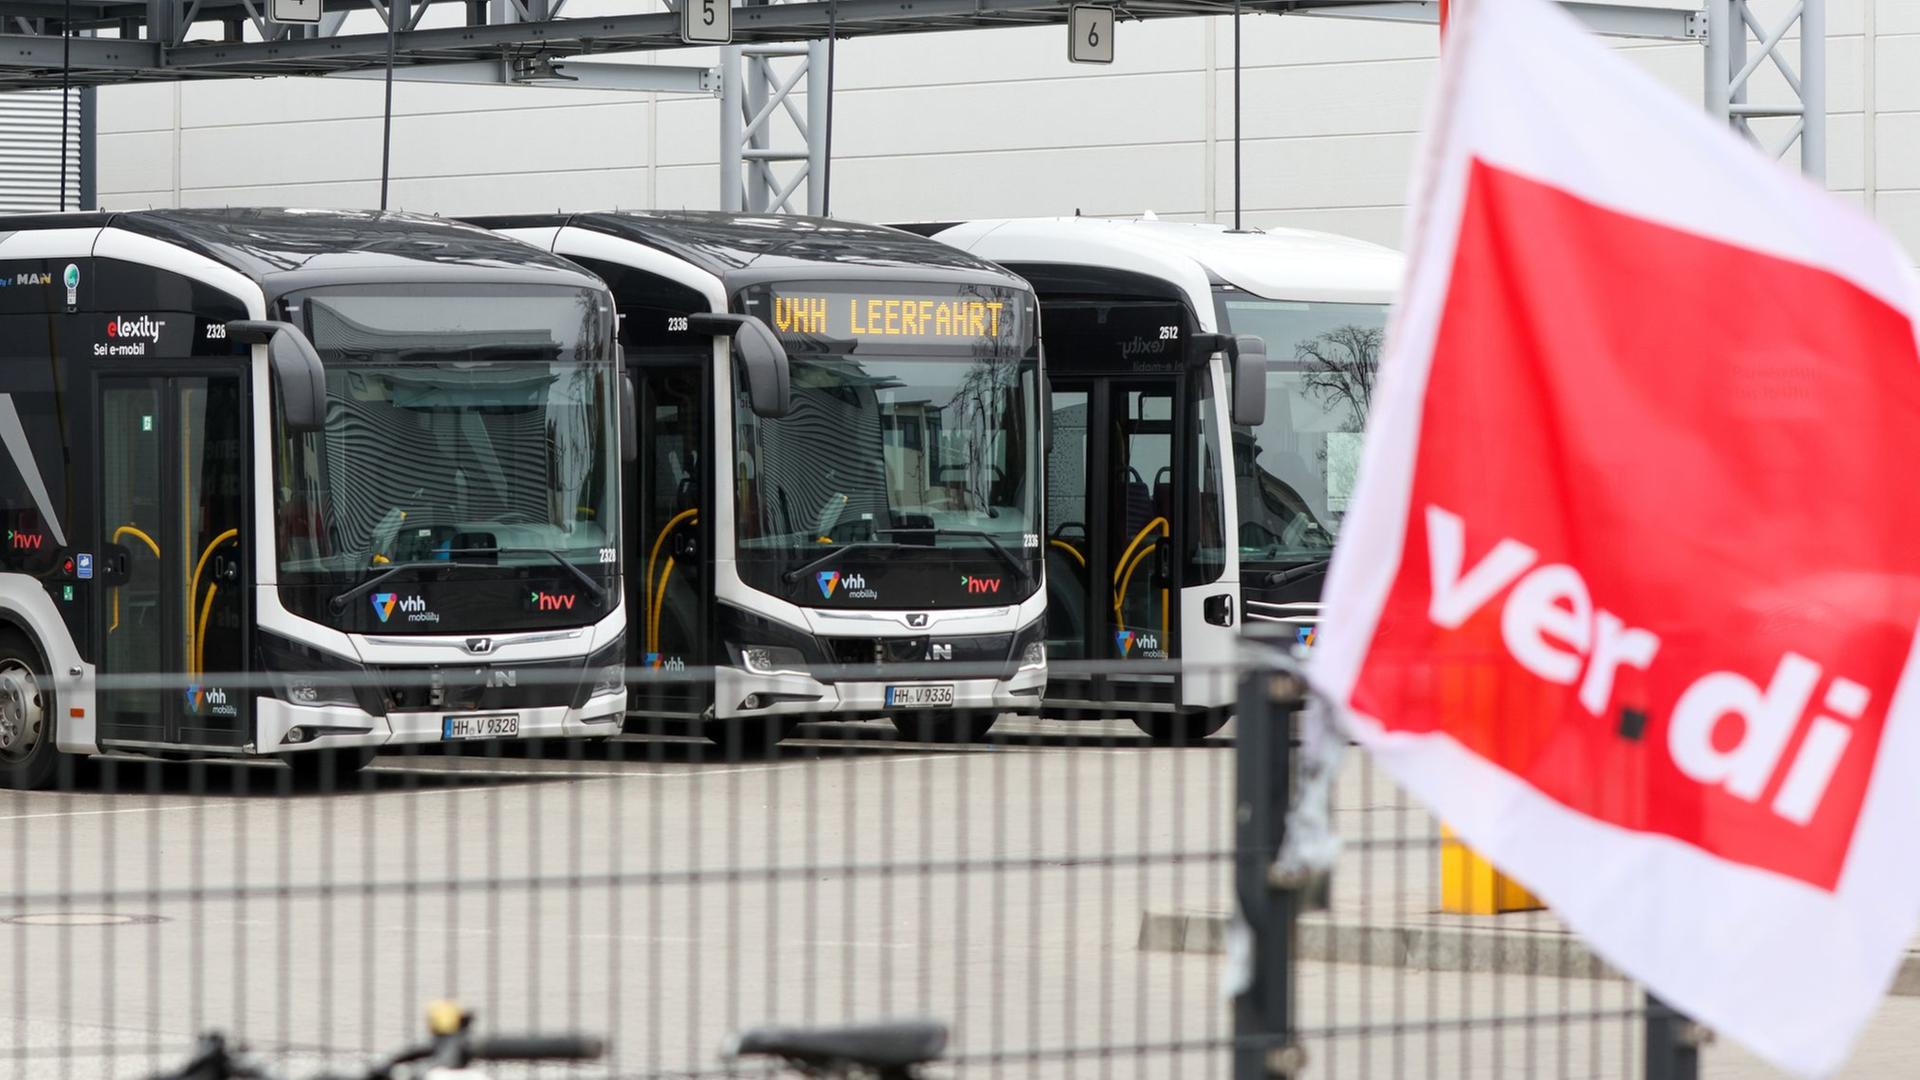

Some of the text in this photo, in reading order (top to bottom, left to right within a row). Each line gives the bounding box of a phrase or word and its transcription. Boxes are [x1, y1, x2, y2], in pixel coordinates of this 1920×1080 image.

[703, 0, 715, 26] 5
[1088, 22, 1099, 47] 6
[17, 273, 52, 285] MAN
[668, 317, 689, 332] 2336
[775, 297, 1004, 338] VHH LEERFAHRT
[1159, 325, 1179, 340] 2512
[93, 341, 145, 356] Sei e-mobil
[14, 530, 43, 549] hvv
[841, 573, 866, 589] vhh
[968, 575, 1001, 593] hvv
[539, 591, 576, 611] hvv
[849, 588, 878, 600] mobility
[399, 595, 426, 612] vhh
[408, 611, 440, 624] mobility
[1135, 634, 1158, 649] vhh
[664, 655, 685, 673] vhh
[1425, 503, 1872, 827] ver.di
[205, 687, 227, 705] vhh
[925, 687, 952, 703] 9336
[487, 717, 518, 734] 9328
